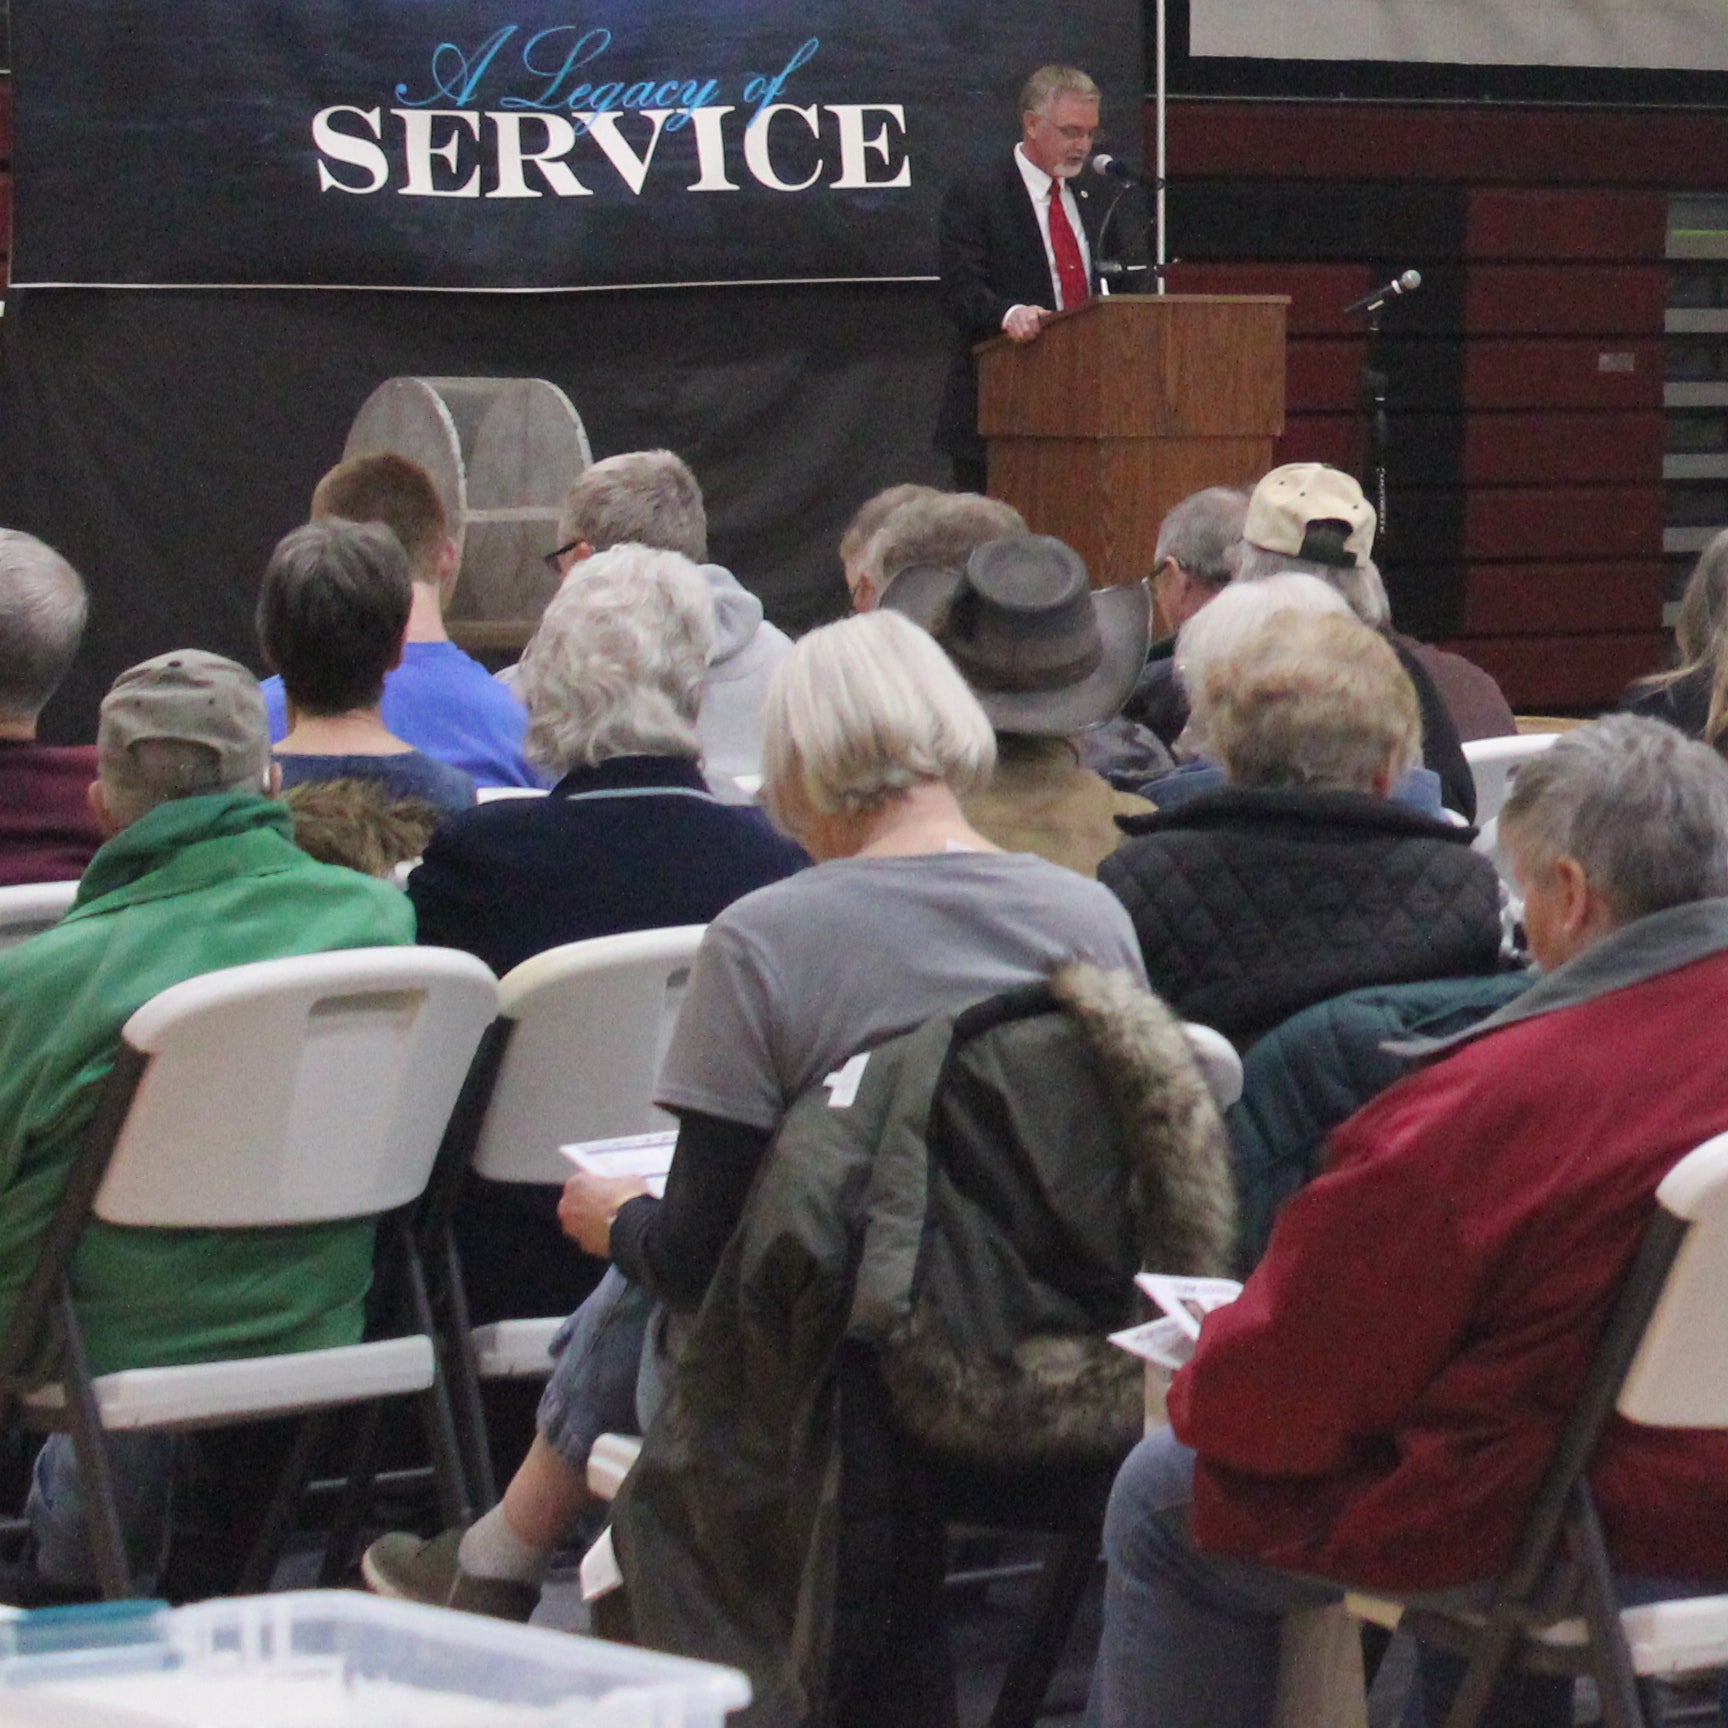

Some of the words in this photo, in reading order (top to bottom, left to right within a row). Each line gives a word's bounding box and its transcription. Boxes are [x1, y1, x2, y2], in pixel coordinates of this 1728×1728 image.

[395, 25, 518, 107] A
[500, 25, 720, 136] Legacy
[743, 37, 820, 129] of
[311, 103, 911, 198] SERVICE
